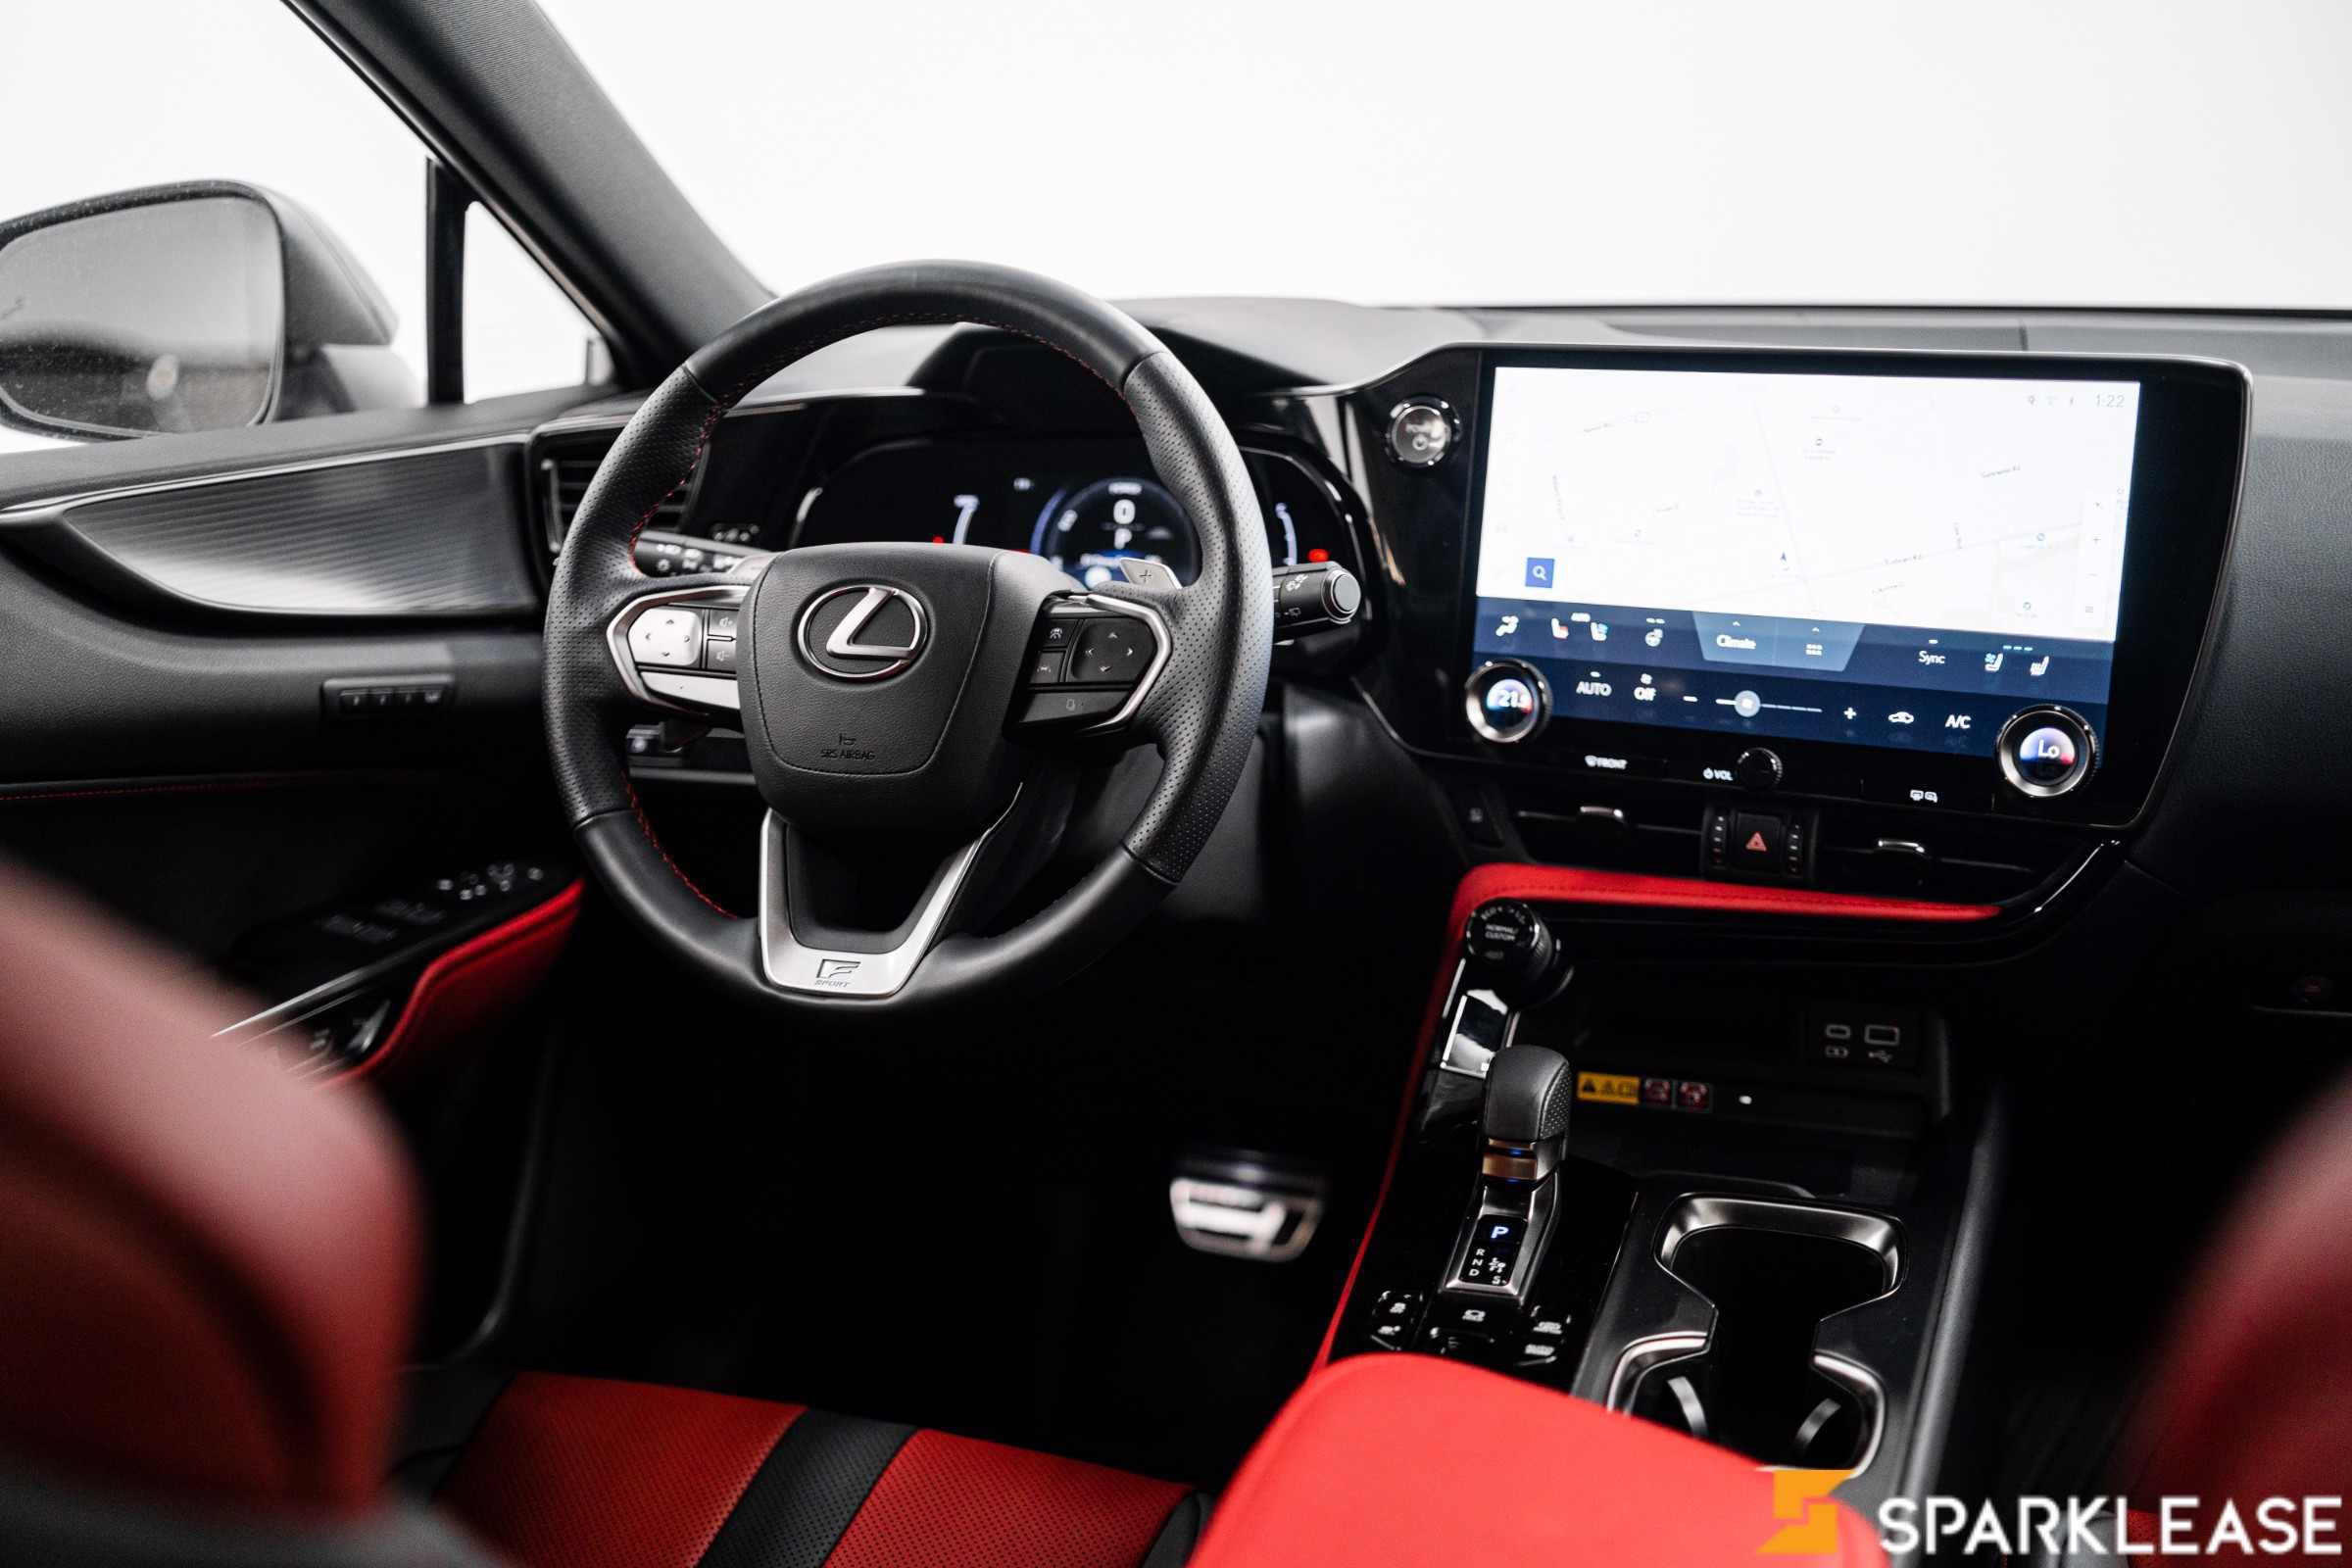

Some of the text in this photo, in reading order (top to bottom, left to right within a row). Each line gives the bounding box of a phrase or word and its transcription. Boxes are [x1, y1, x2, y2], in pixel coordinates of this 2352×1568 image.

[2095, 394, 2126, 408] 1:22
[1918, 650, 1946, 665] Sync
[1576, 681, 1612, 697] AUTO
[1944, 714, 1972, 729] A/C
[2037, 739, 2059, 759] Lo
[1713, 768, 1733, 781] VOL
[1491, 1226, 1509, 1239] P
